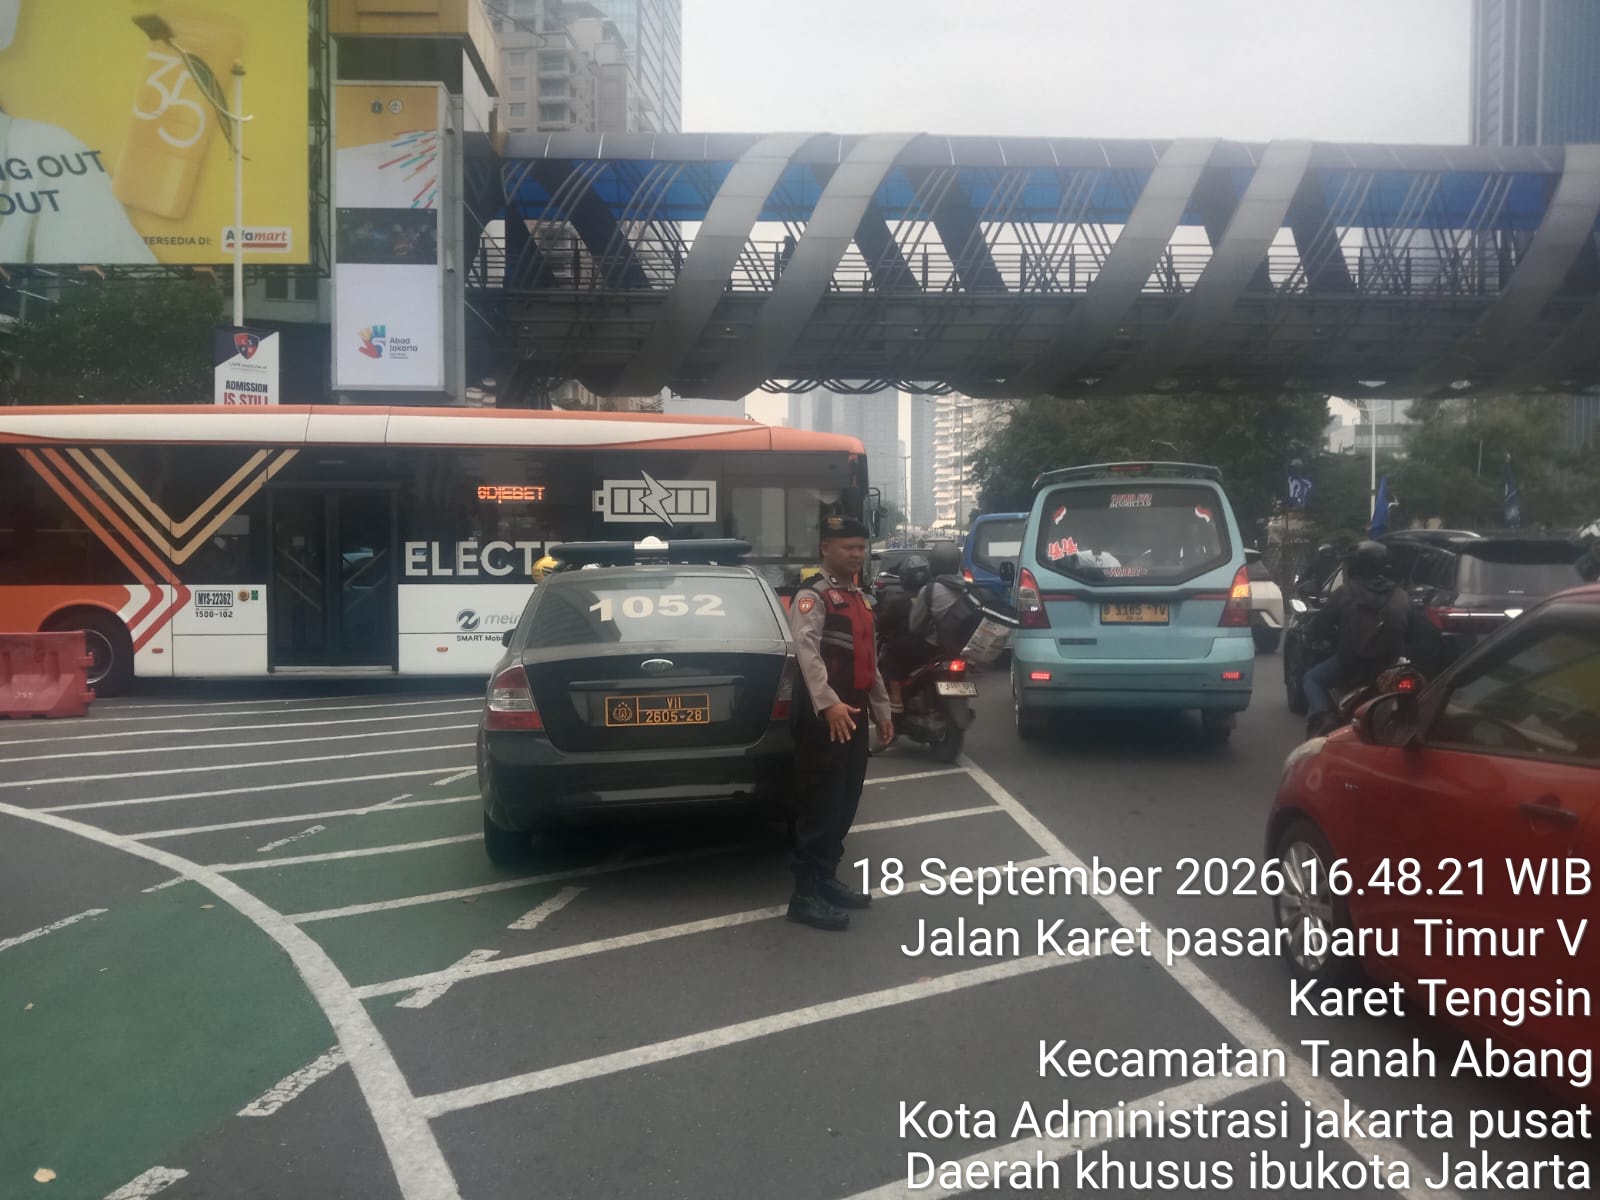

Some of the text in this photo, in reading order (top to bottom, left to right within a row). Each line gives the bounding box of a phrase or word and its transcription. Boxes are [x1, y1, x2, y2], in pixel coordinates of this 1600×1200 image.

[132, 50, 206, 147] 35
[0, 150, 105, 181] G OUT
[144, 236, 194, 246] TERSEDIA
[226, 380, 268, 393] ADMISSION
[224, 392, 235, 405] IS
[405, 541, 566, 577] ELECT
[589, 594, 726, 622] 1052
[645, 710, 702, 723] 2605-28
